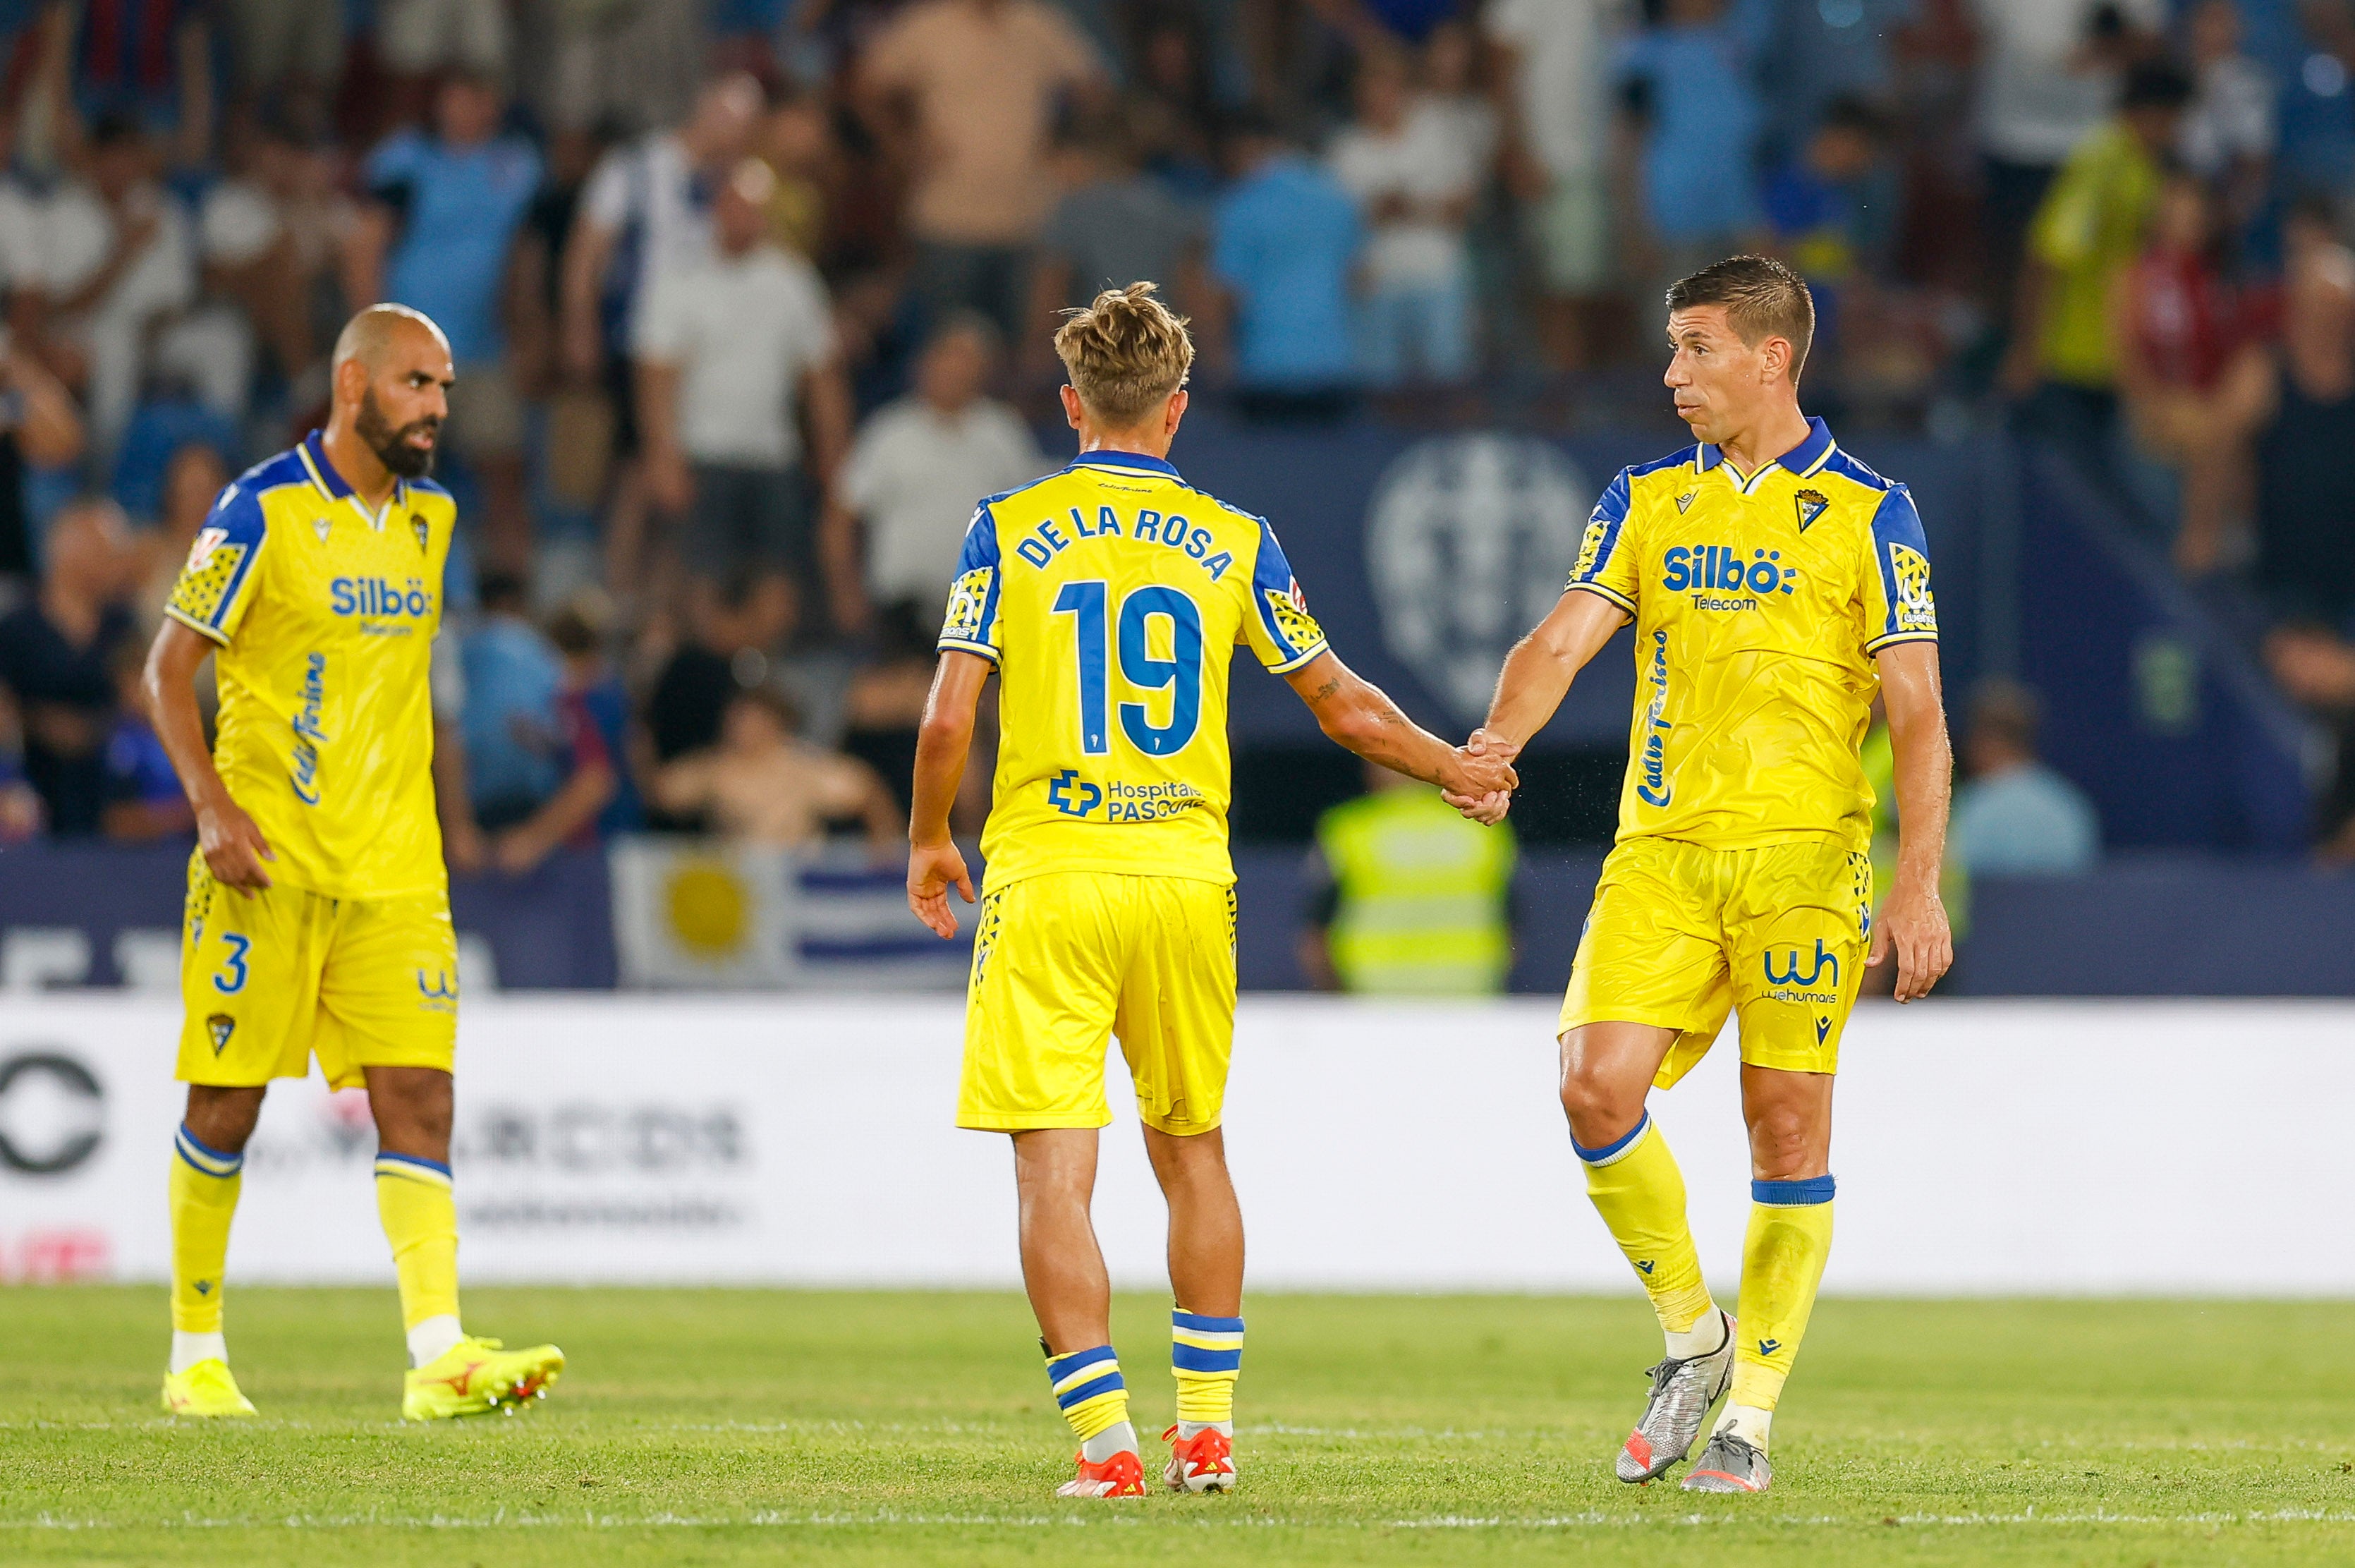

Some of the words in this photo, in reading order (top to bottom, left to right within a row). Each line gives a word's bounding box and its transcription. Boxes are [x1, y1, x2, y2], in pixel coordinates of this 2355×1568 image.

[1016, 519, 1070, 570] DE
[1070, 506, 1121, 538] LA
[1133, 509, 1233, 582] ROSA
[944, 580, 975, 624] h
[1692, 594, 1757, 611] Telecom
[1902, 577, 1935, 612] w
[1052, 580, 1203, 757] 19
[213, 932, 251, 994] 3
[418, 969, 458, 1001] w
[1761, 989, 1837, 1004] wehumans
